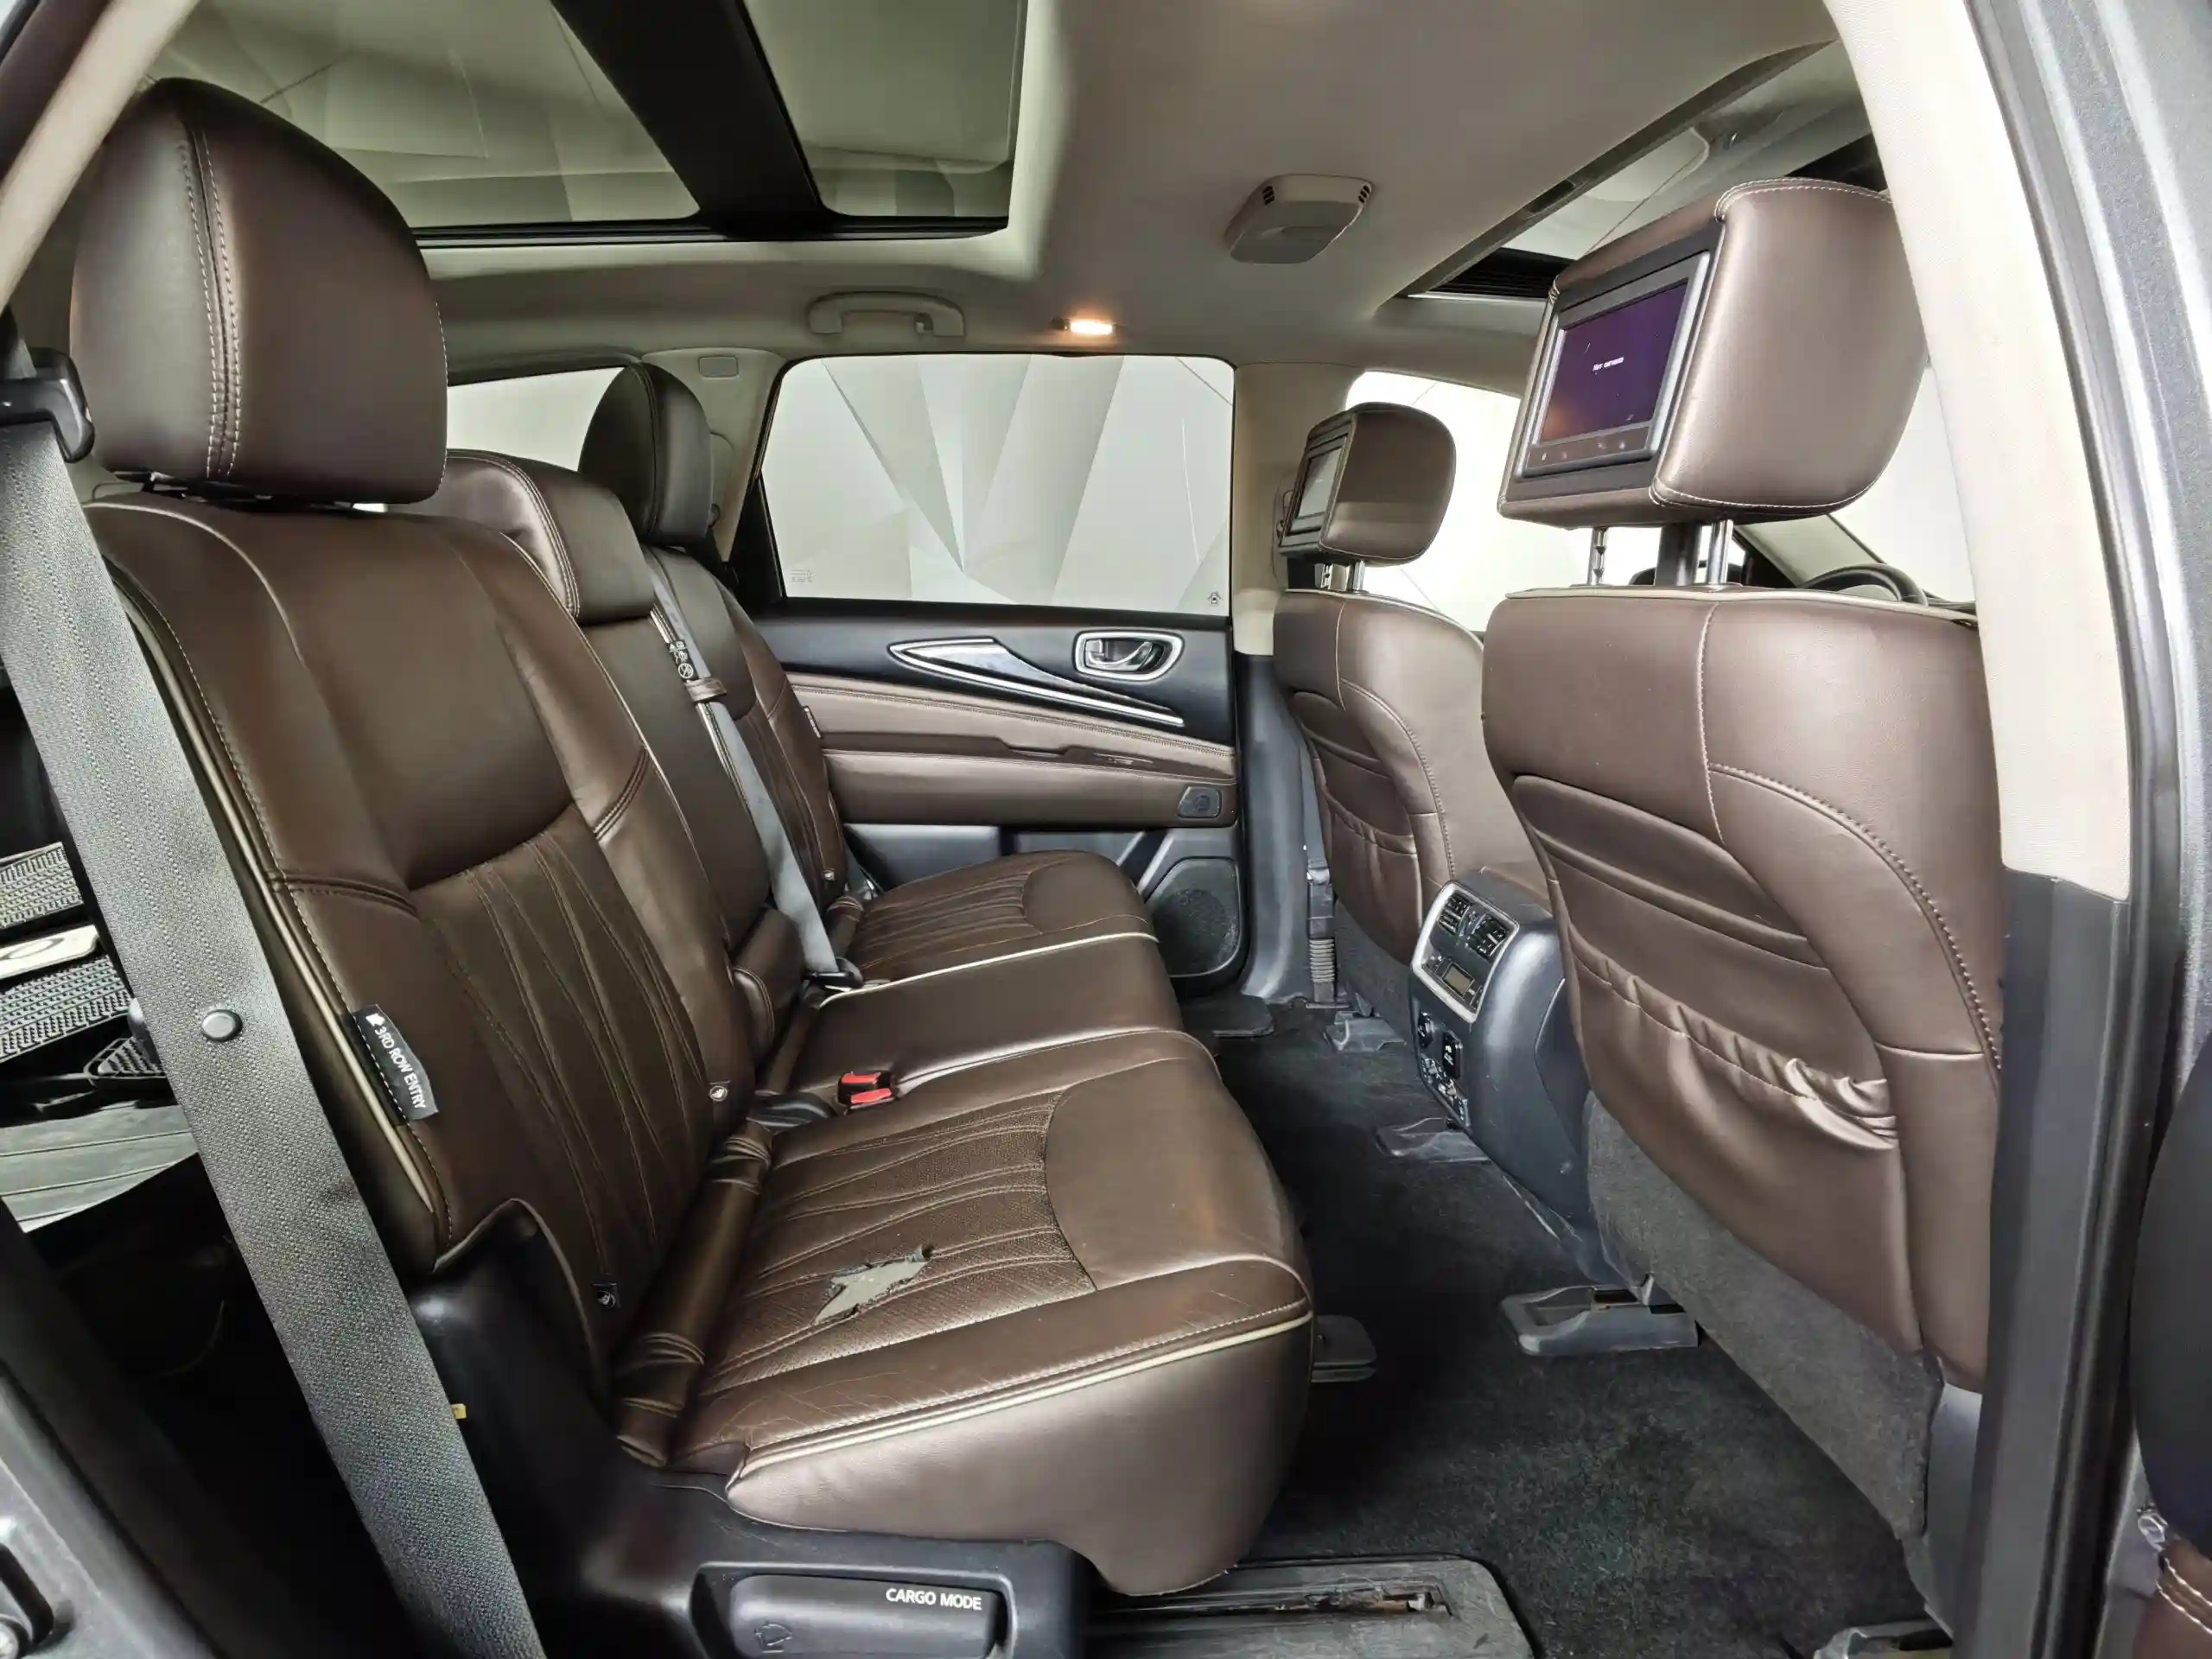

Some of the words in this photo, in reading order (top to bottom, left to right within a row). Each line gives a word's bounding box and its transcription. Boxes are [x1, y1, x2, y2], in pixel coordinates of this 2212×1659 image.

[374, 1026, 394, 1048] 3RD
[389, 1047, 413, 1072] ROW
[404, 1072, 426, 1109] ENTRY
[886, 1588, 937, 1605] CARGO
[939, 1592, 982, 1611] MODE
